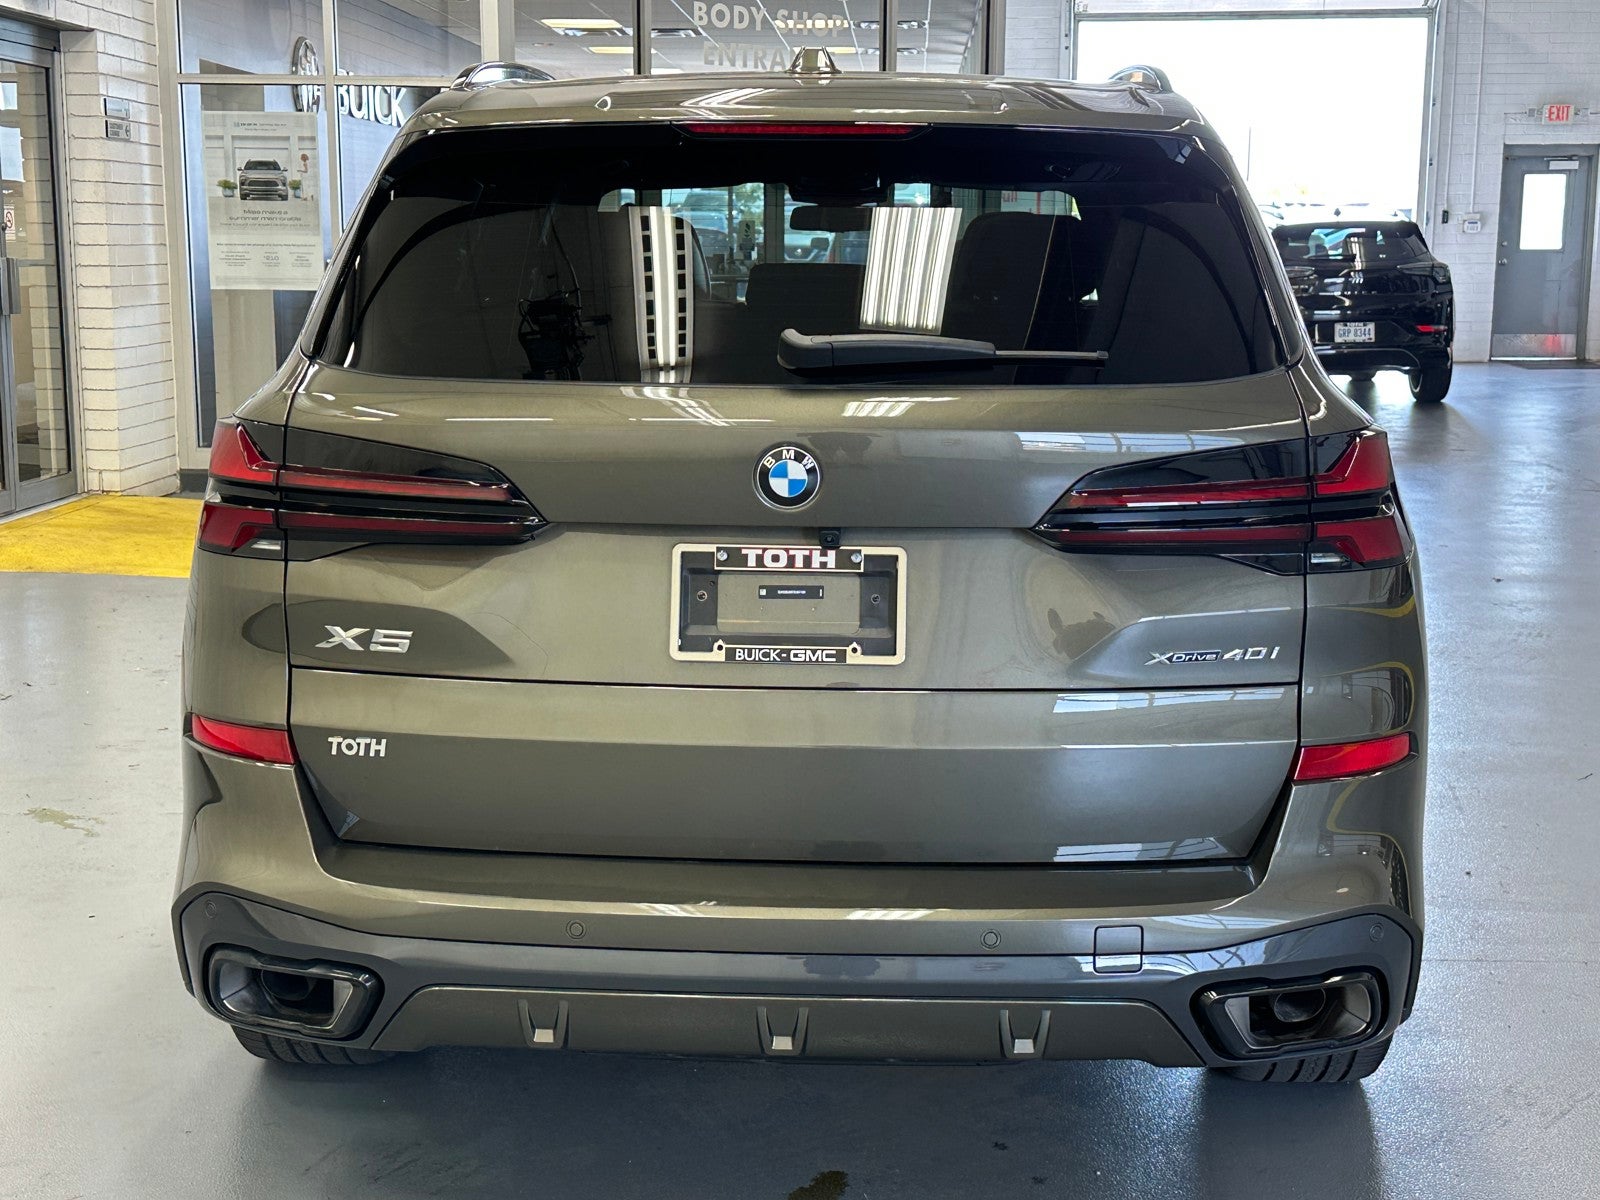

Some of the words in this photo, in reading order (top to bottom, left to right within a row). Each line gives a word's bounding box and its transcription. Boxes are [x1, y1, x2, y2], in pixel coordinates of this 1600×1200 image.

[693, 1, 766, 31] BODY
[776, 9, 844, 38] SHOP
[703, 40, 798, 71] ENTRA
[337, 68, 407, 127] BUICK
[1548, 104, 1571, 122] EXIT
[1338, 327, 1351, 338] GRP
[1353, 327, 1371, 338] 8344
[763, 449, 815, 470] BMW
[741, 548, 836, 569] TOTH
[315, 625, 414, 654] X5
[327, 736, 387, 757] TOTH
